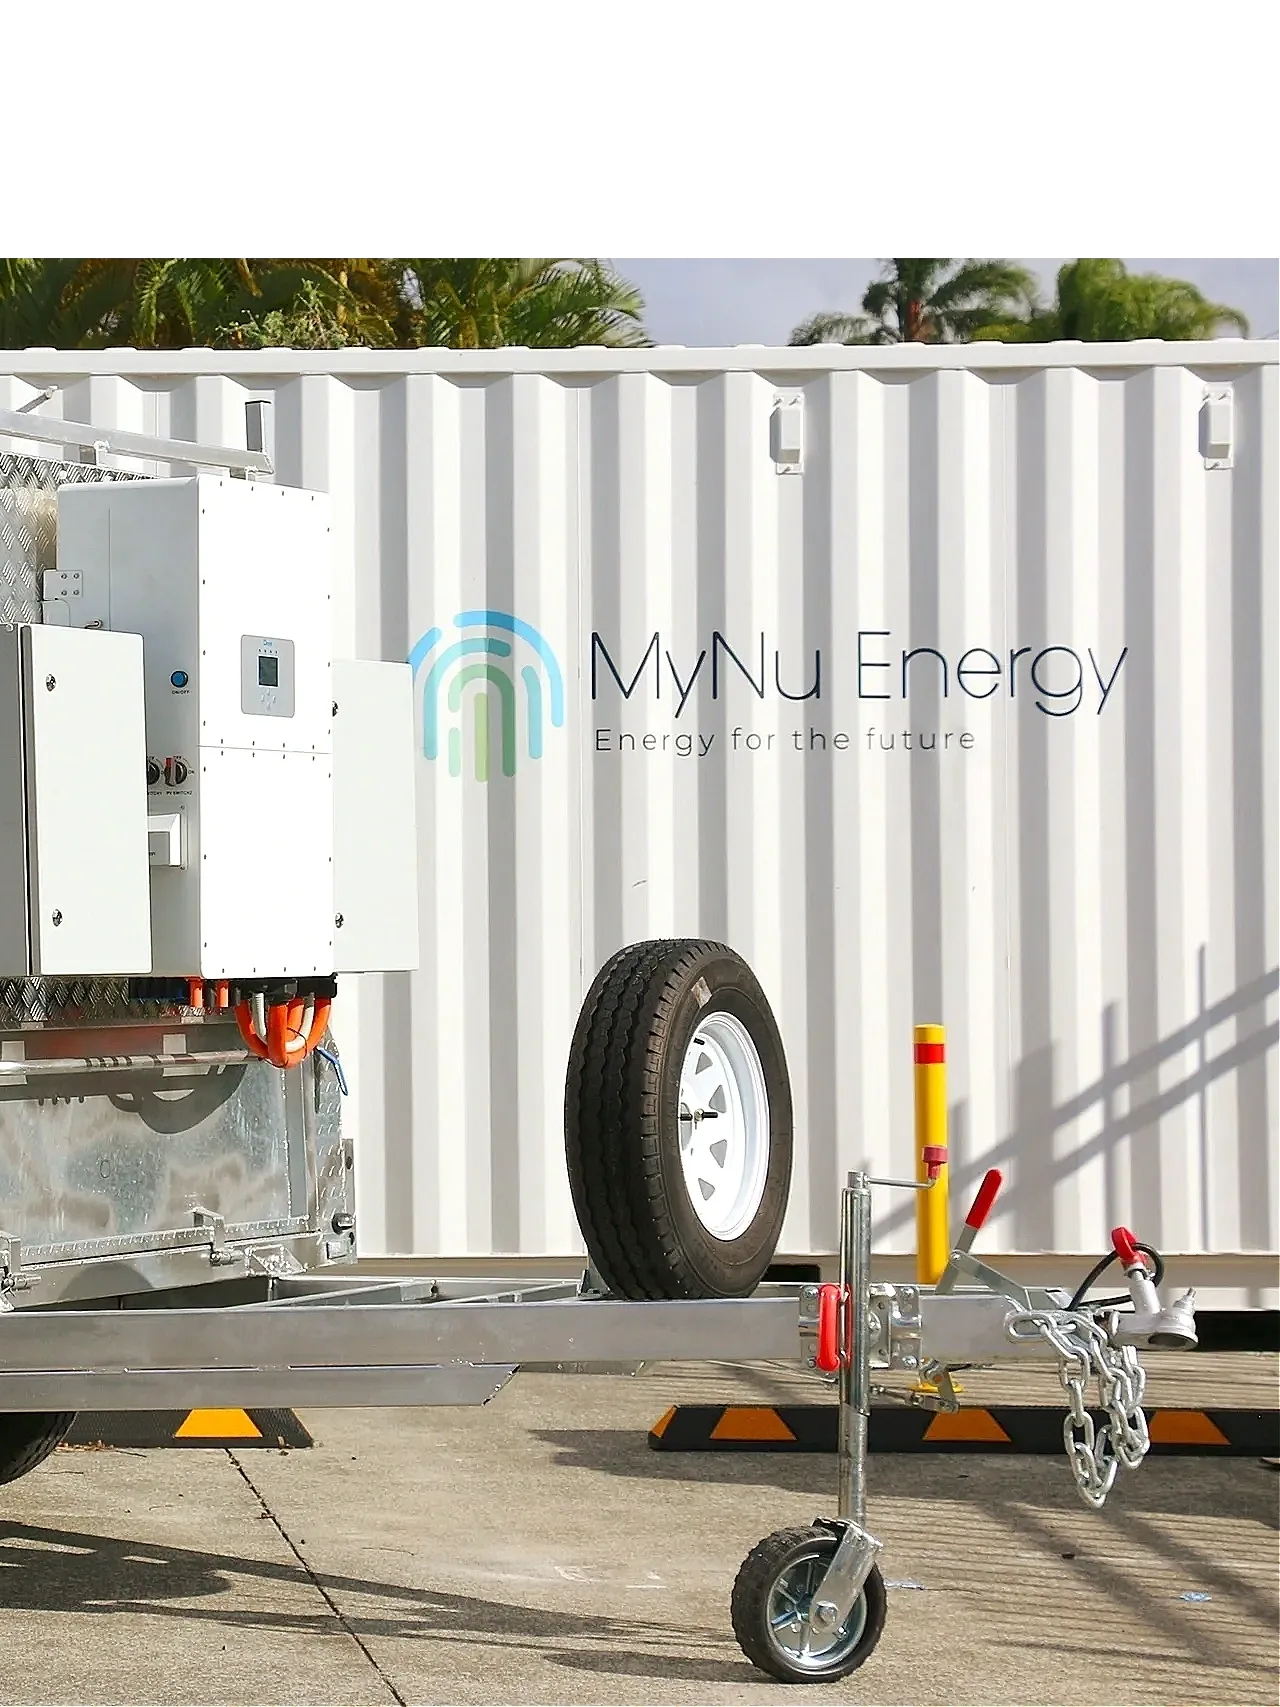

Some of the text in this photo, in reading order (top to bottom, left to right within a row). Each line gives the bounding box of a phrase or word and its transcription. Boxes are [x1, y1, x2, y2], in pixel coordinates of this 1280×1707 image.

[590, 630, 1129, 719] MyNu Energy
[594, 726, 976, 758] Energy for the future
